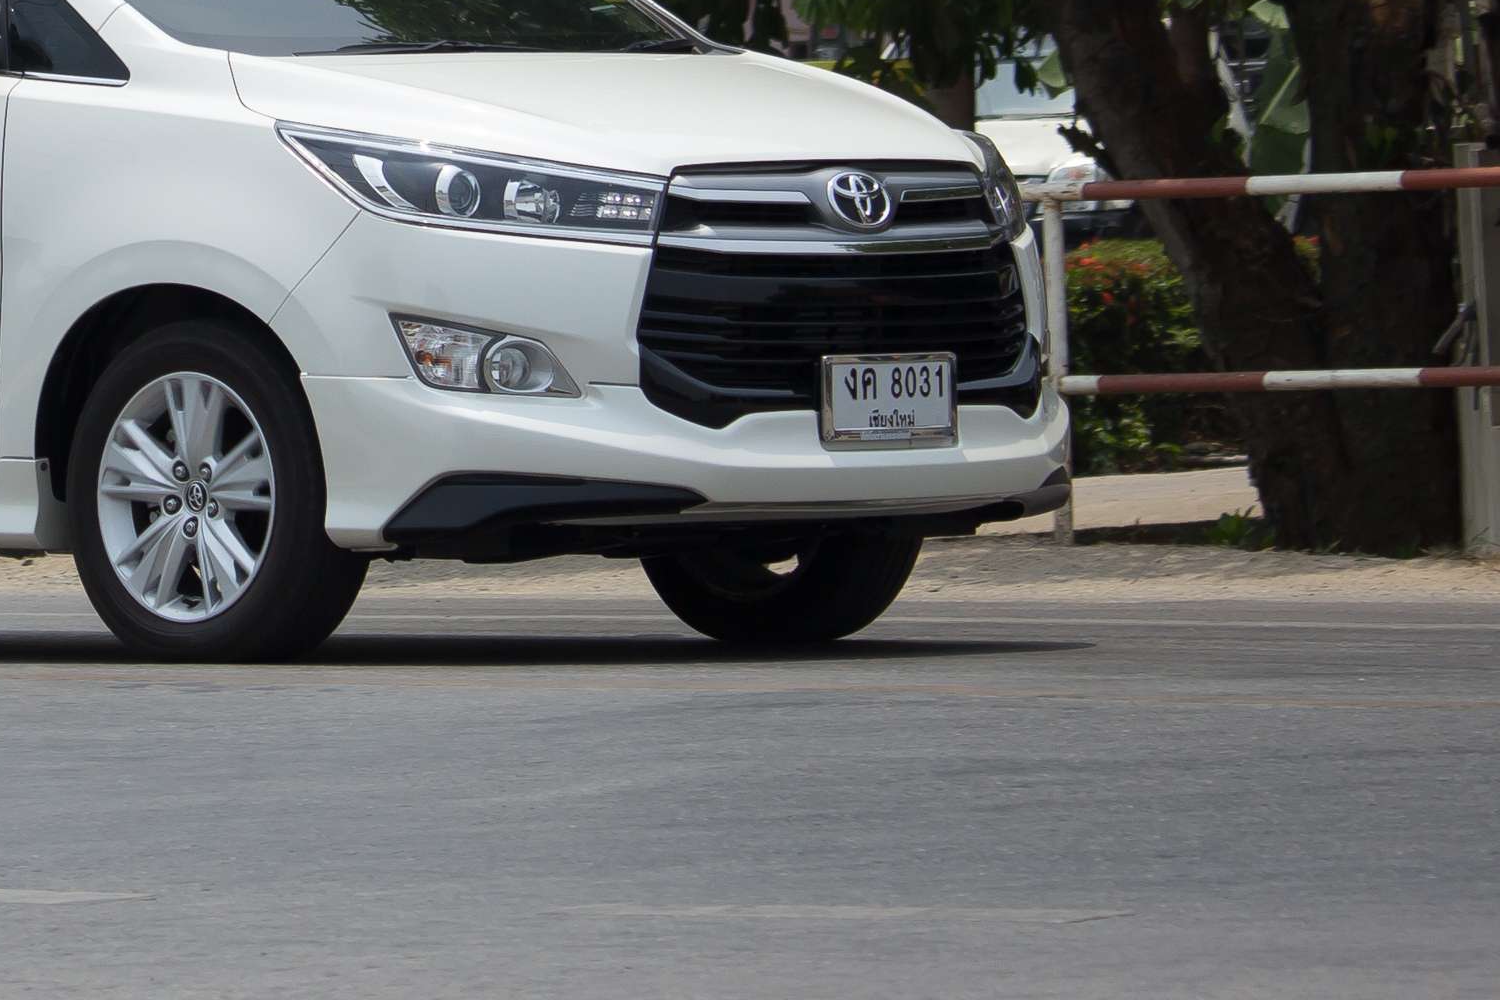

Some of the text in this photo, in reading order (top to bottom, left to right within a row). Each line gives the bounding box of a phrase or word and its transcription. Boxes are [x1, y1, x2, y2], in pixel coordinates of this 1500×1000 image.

[844, 364, 944, 401] งค 8031
[868, 409, 916, 428] เชียงใหม่
